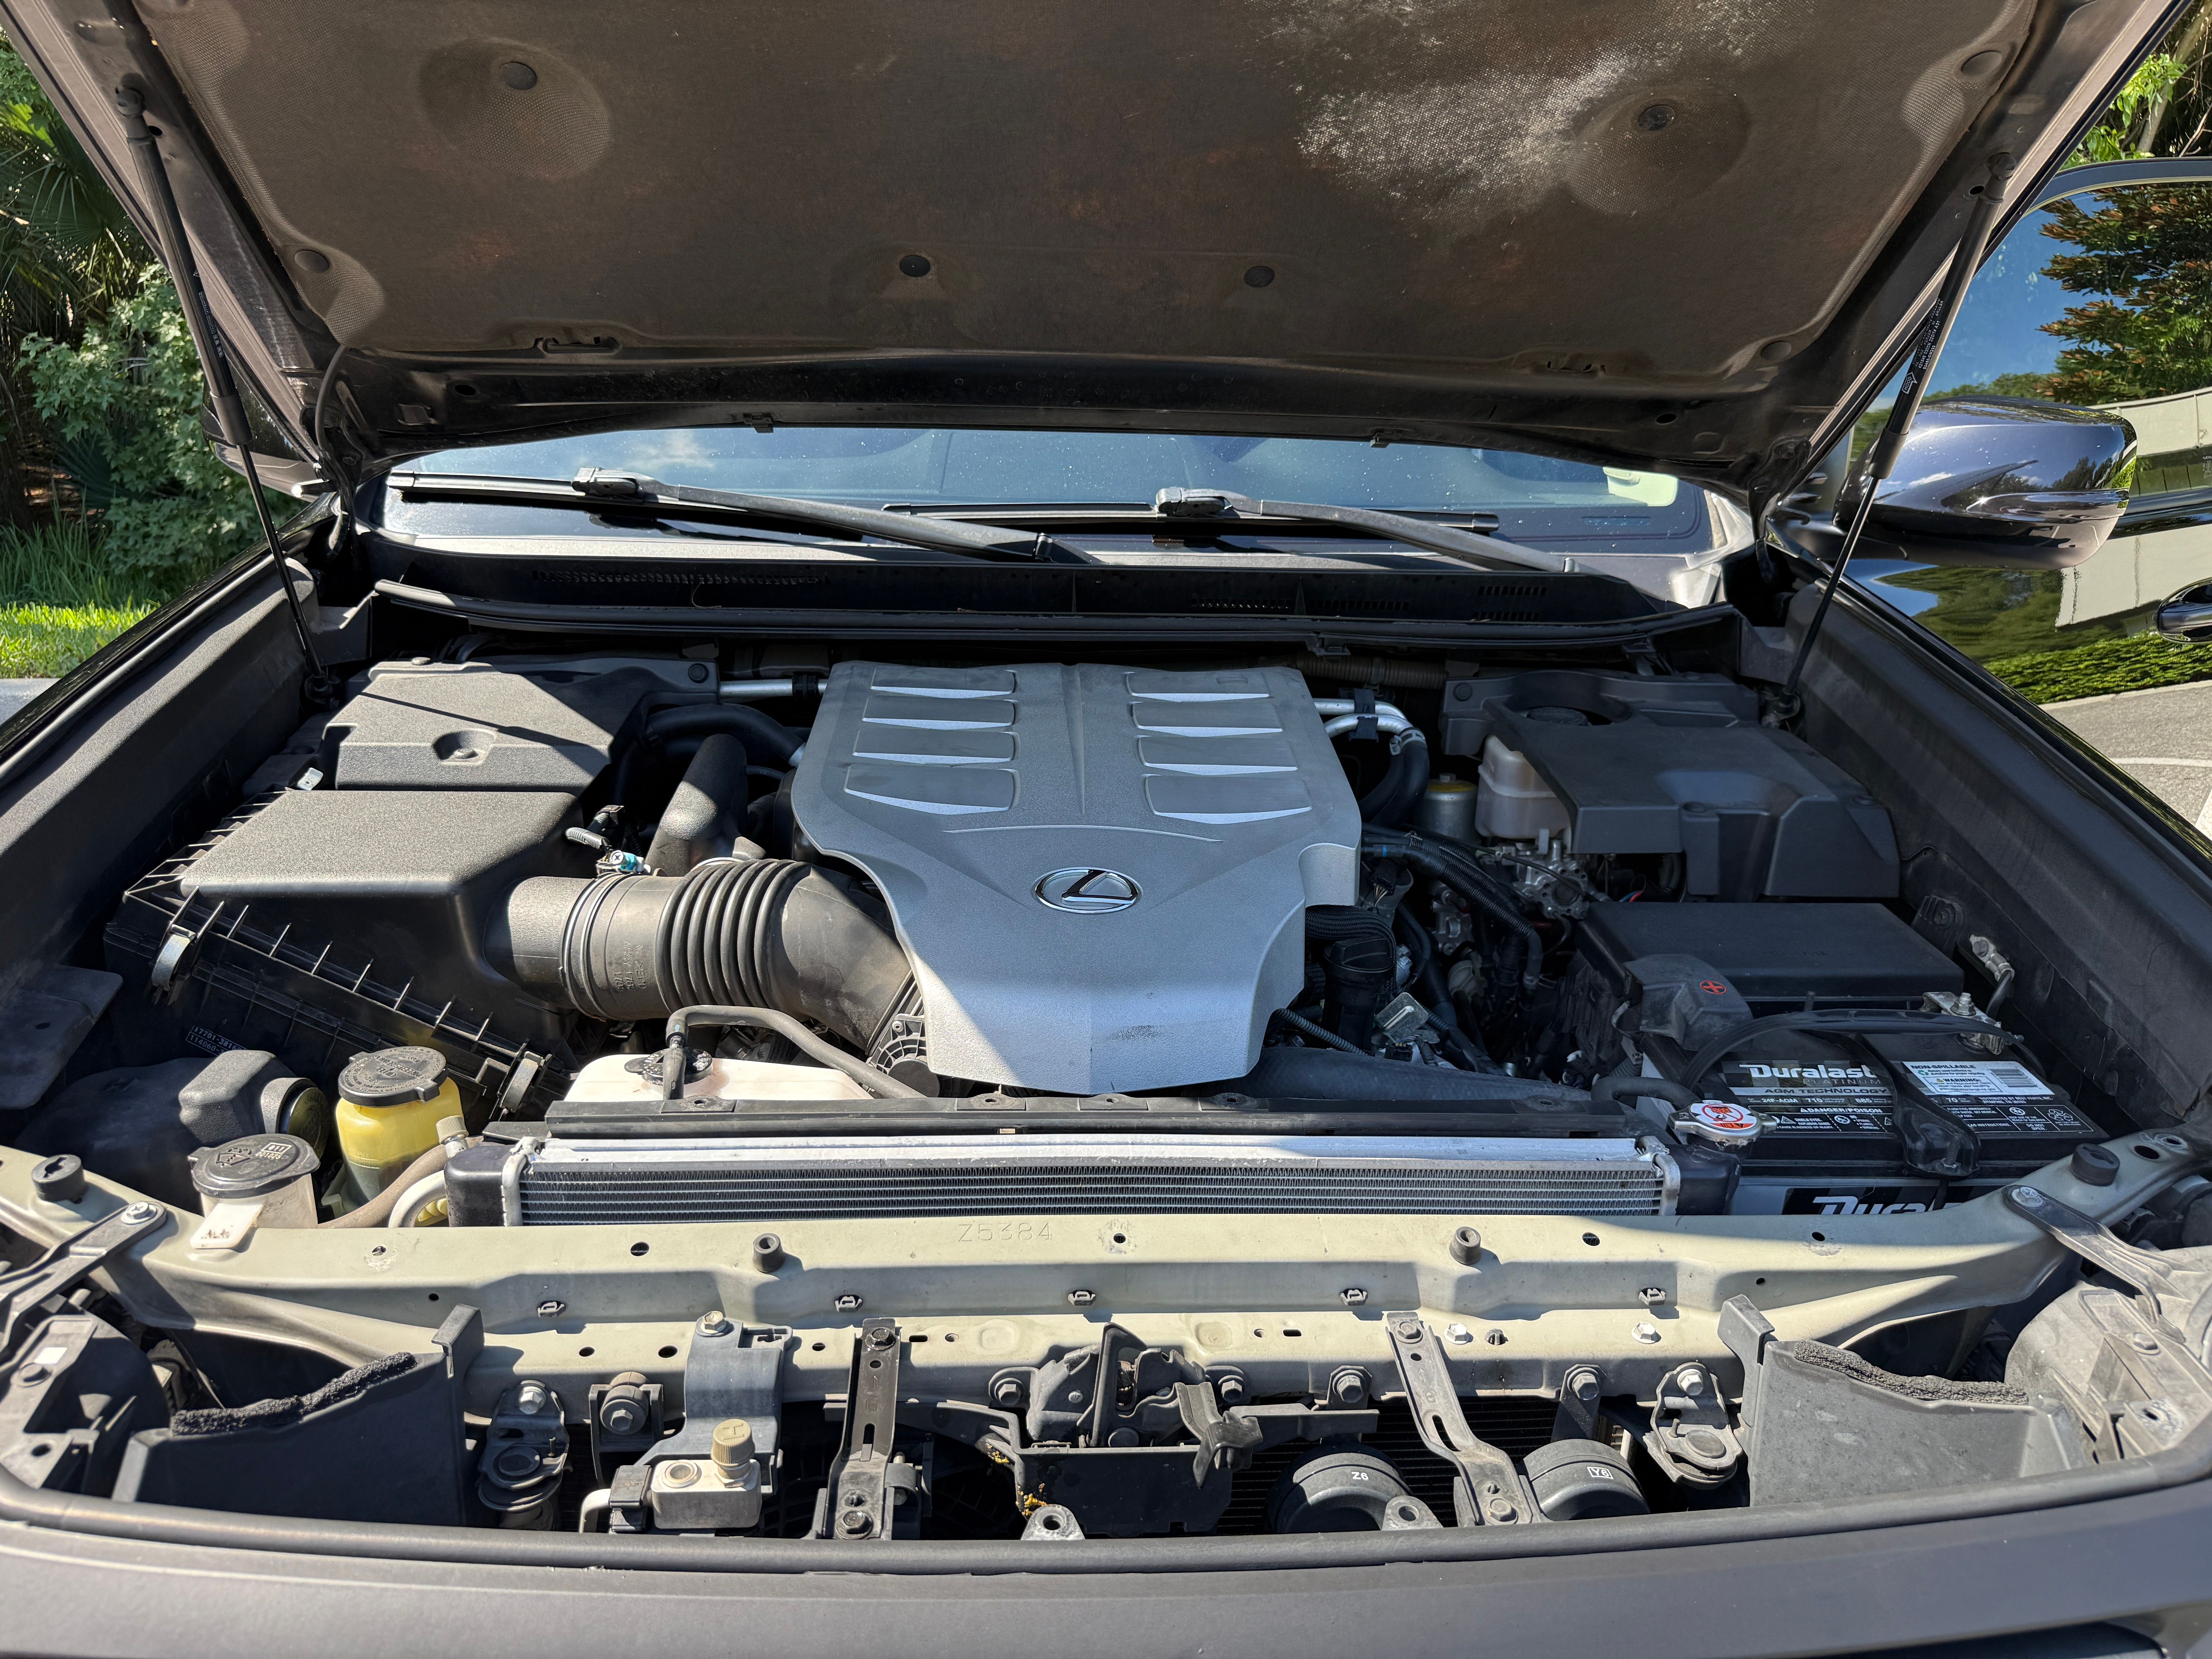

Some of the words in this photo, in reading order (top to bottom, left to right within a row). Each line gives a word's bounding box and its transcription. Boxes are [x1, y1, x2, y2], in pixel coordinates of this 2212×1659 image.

[1904, 376, 1912, 391] HOOD
[1739, 1064, 1877, 1078] Duralast
[958, 1222, 1053, 1242] Z5384
[1351, 1472, 1369, 1480] Z6
[1590, 1468, 1609, 1477] Y6
